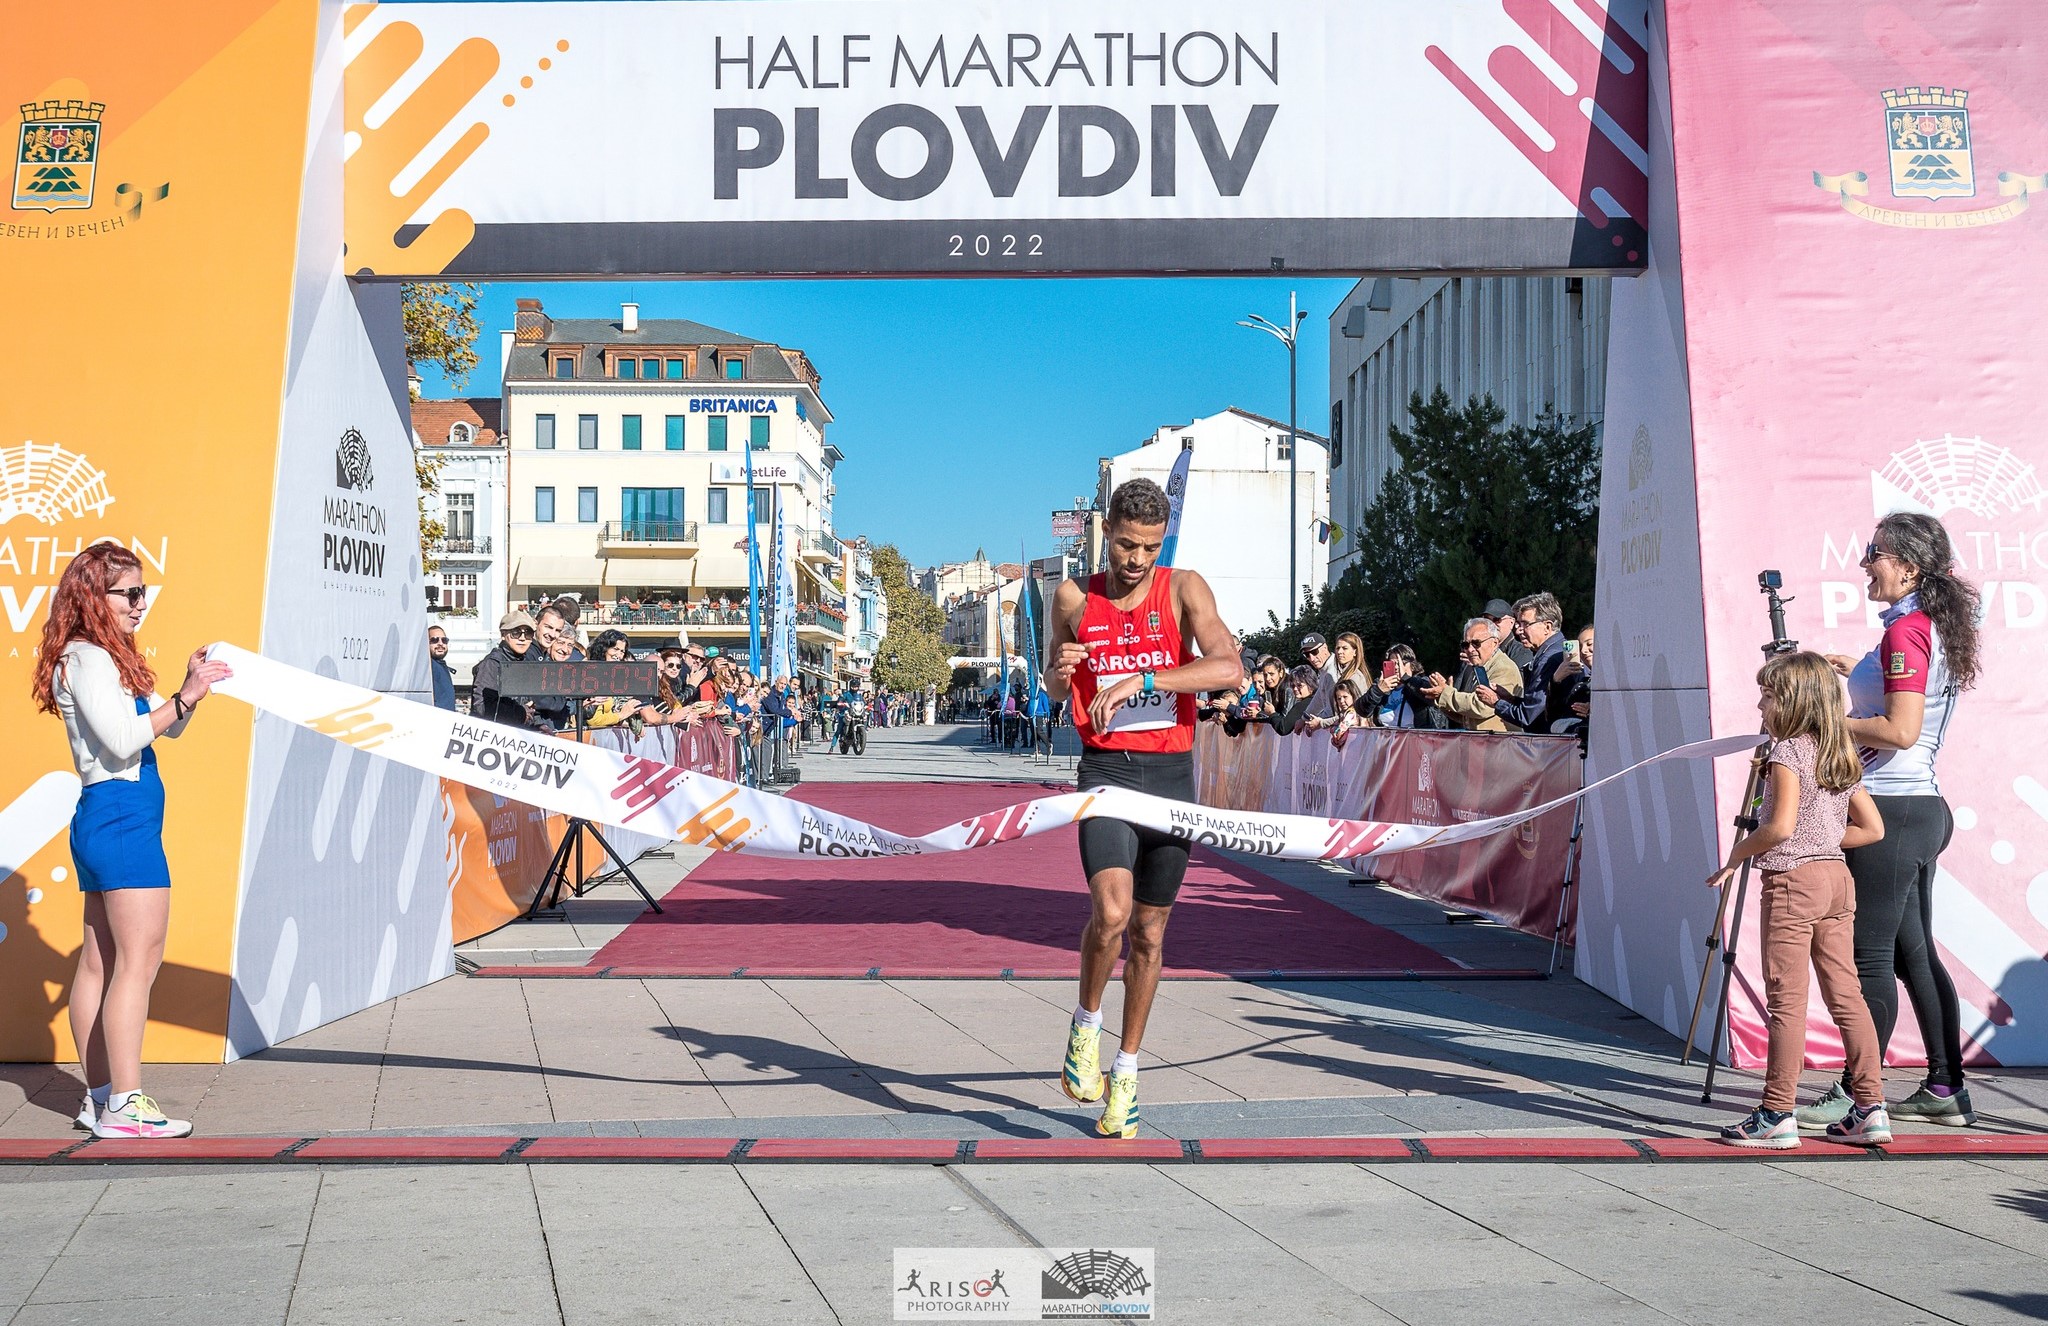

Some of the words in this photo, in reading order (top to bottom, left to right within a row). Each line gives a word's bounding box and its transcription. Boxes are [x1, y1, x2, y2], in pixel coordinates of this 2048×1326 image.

[714, 34, 871, 90] HALF
[889, 31, 1279, 89] MARATHON
[712, 102, 1280, 202] PLOVDIV
[47, 226, 59, 239] И
[66, 216, 125, 238] ВЕЧЕН
[1934, 213, 1947, 228] И
[1954, 205, 2014, 226] ВЕЧЕН
[948, 233, 1044, 257] 2022
[689, 398, 778, 413] BRITANICA
[740, 466, 787, 478] MetLife
[323, 495, 386, 537] MARATHON
[1621, 490, 1663, 532] MARATHON
[0, 536, 169, 576] ATHN
[323, 532, 386, 579] PLOVDIV
[1621, 527, 1663, 576] PLOVDIV
[342, 636, 369, 661] 2022
[1087, 650, 1175, 674] CÁRCOBA
[540, 664, 653, 694] 1:06:04
[451, 722, 490, 743] HALF
[490, 733, 579, 766] MARATHON
[444, 738, 575, 790] PLOVDIV
[489, 777, 518, 791] 2022
[801, 815, 834, 836] HALF
[835, 826, 920, 852] MARATHON
[1170, 809, 1203, 827] HALF
[1206, 816, 1286, 839] MARATHON
[487, 836, 518, 869] PLOVDIV
